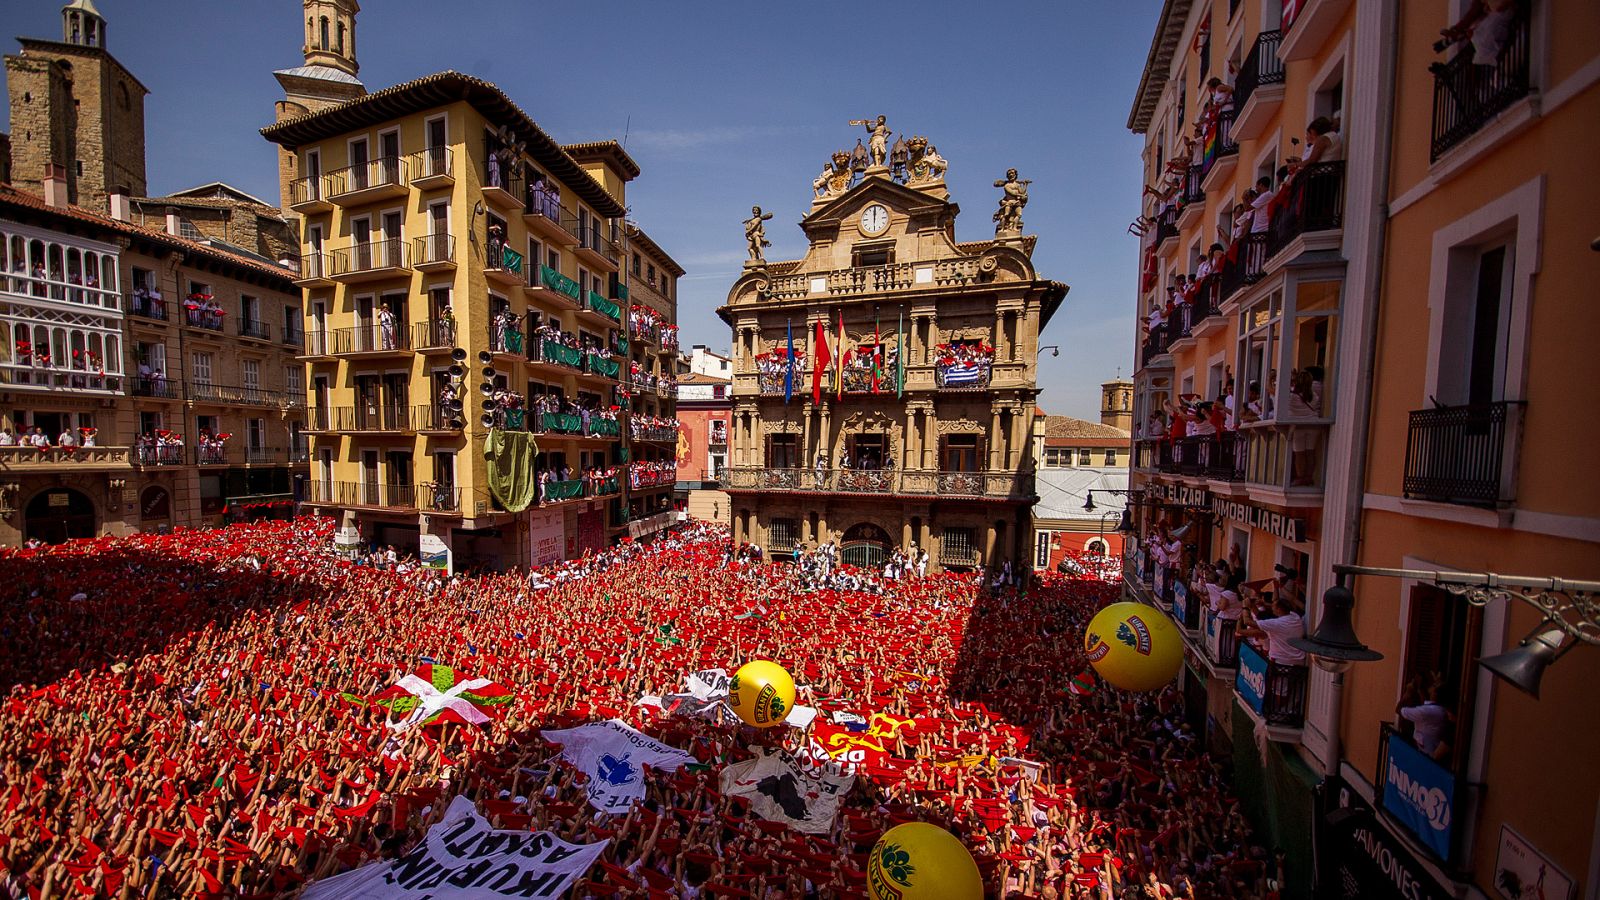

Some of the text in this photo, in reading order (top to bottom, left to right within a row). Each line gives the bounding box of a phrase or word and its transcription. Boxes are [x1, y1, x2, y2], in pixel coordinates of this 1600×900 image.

[1168, 484, 1205, 506] ELIZARI
[1212, 497, 1297, 542] INMOBILIARIA
[1131, 617, 1149, 653] URZANTE
[755, 686, 773, 723] URZANTE
[440, 817, 583, 864] ASKATU
[1353, 828, 1421, 900] JAMONES
